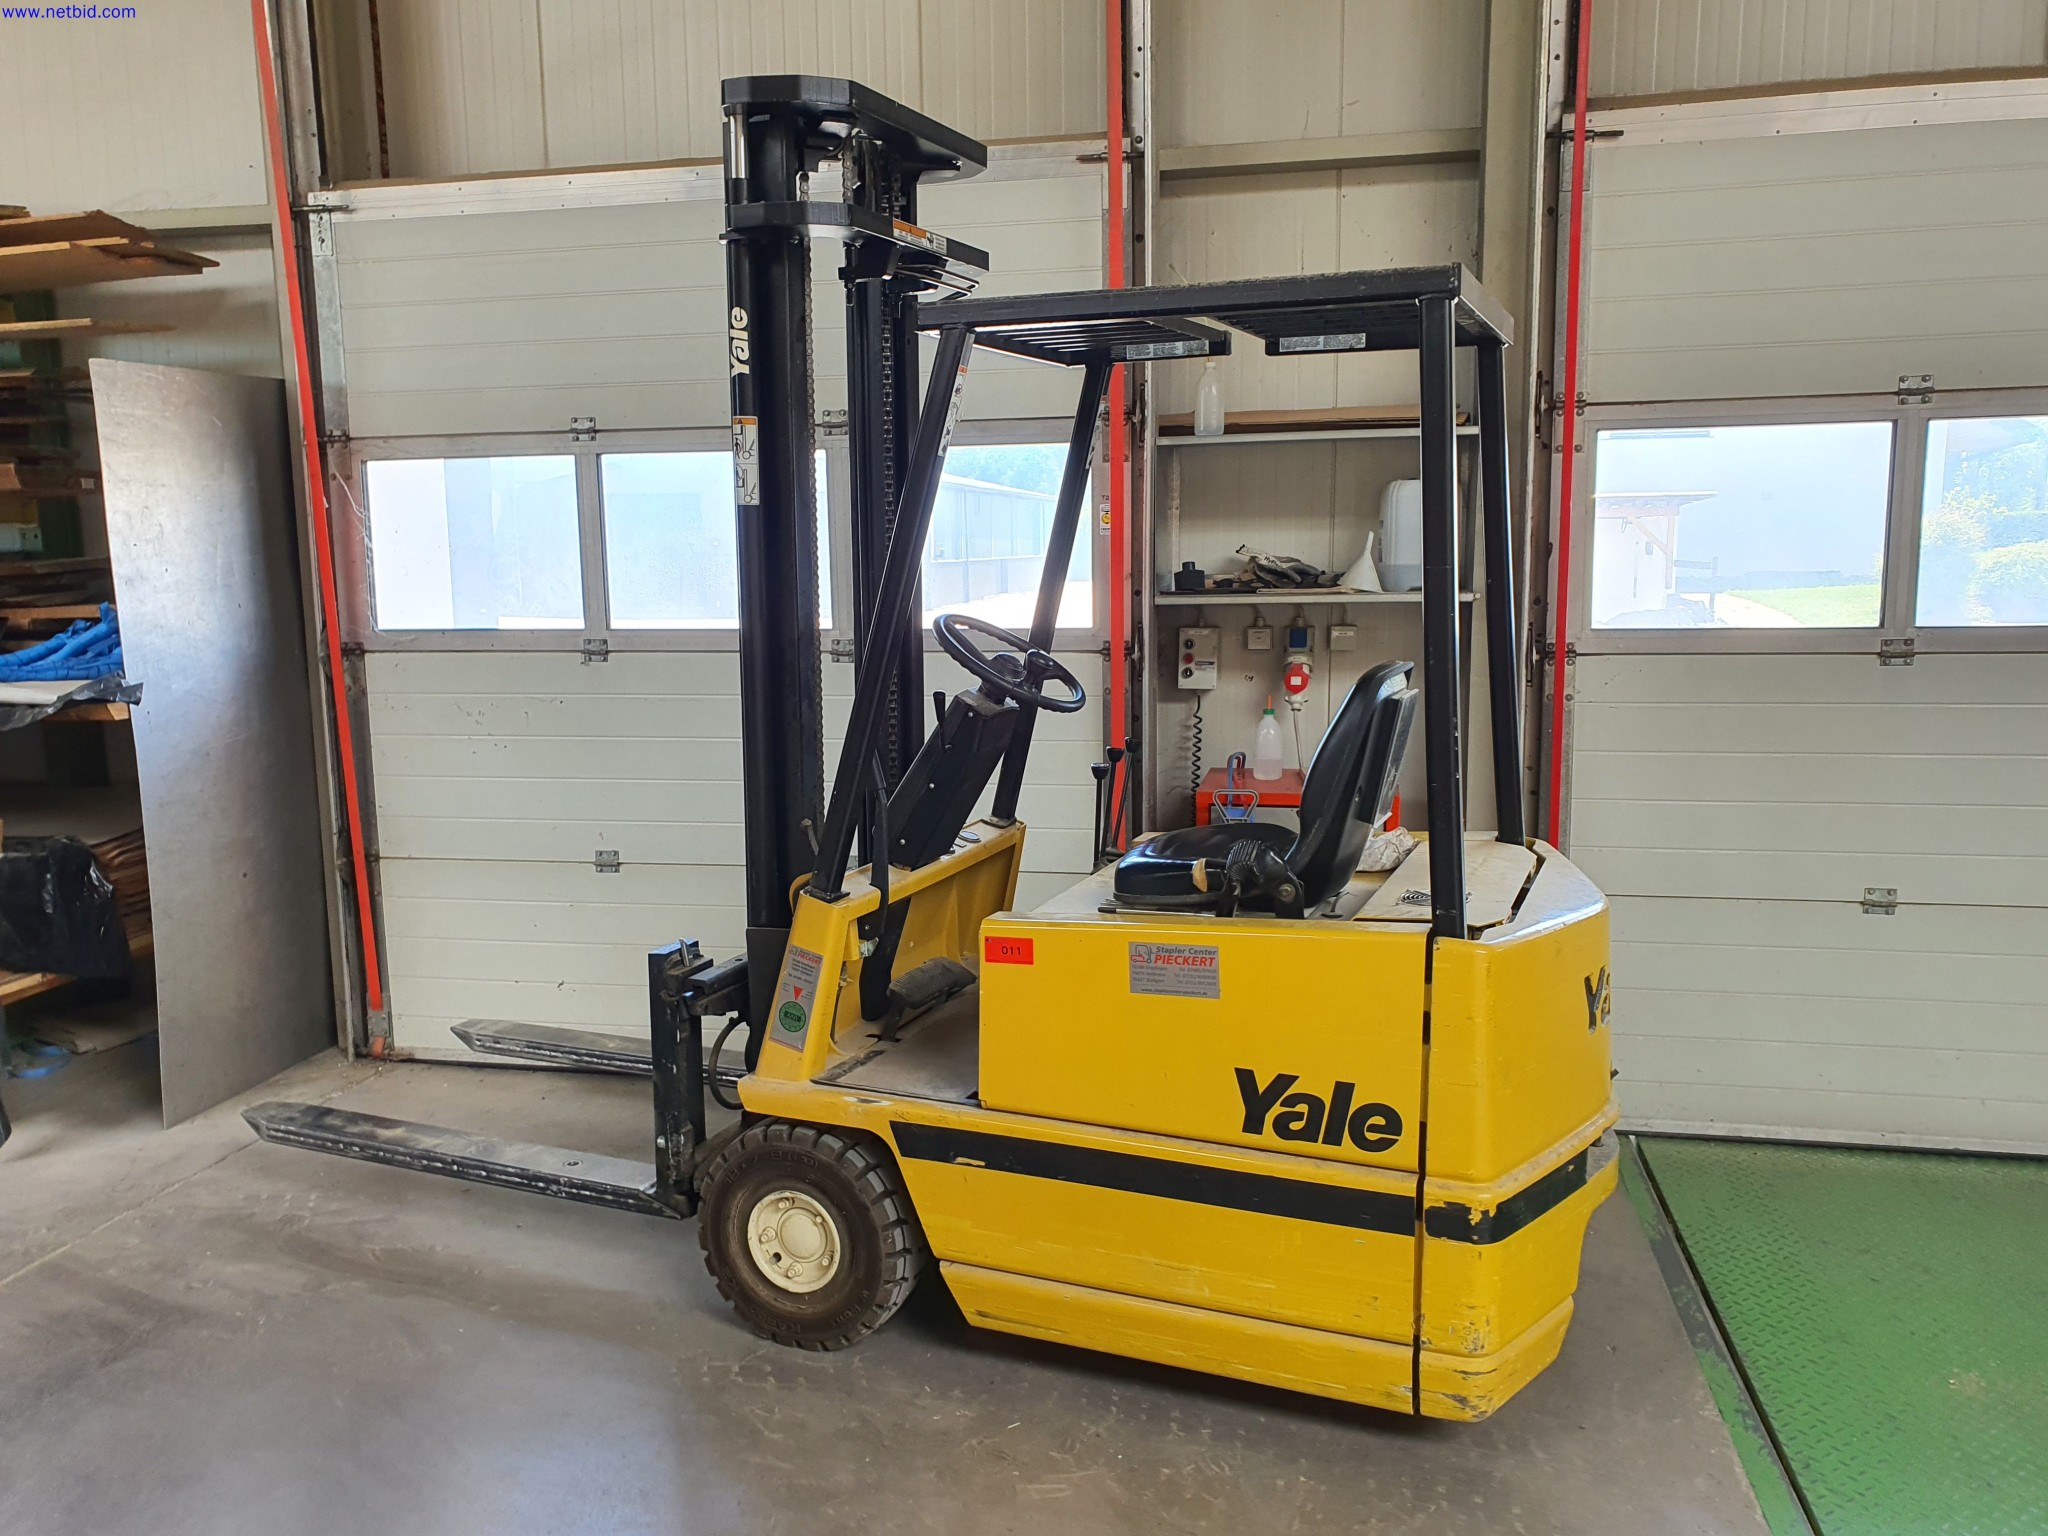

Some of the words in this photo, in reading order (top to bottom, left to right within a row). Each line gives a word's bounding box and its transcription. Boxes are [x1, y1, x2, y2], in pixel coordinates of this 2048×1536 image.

[729, 306, 750, 378] Yale
[1001, 945, 1021, 956] 011
[1155, 946, 1186, 955] Stapler
[1188, 947, 1217, 956] Center
[1154, 954, 1216, 967] PIECKERT
[1233, 1066, 1403, 1153] Yale
